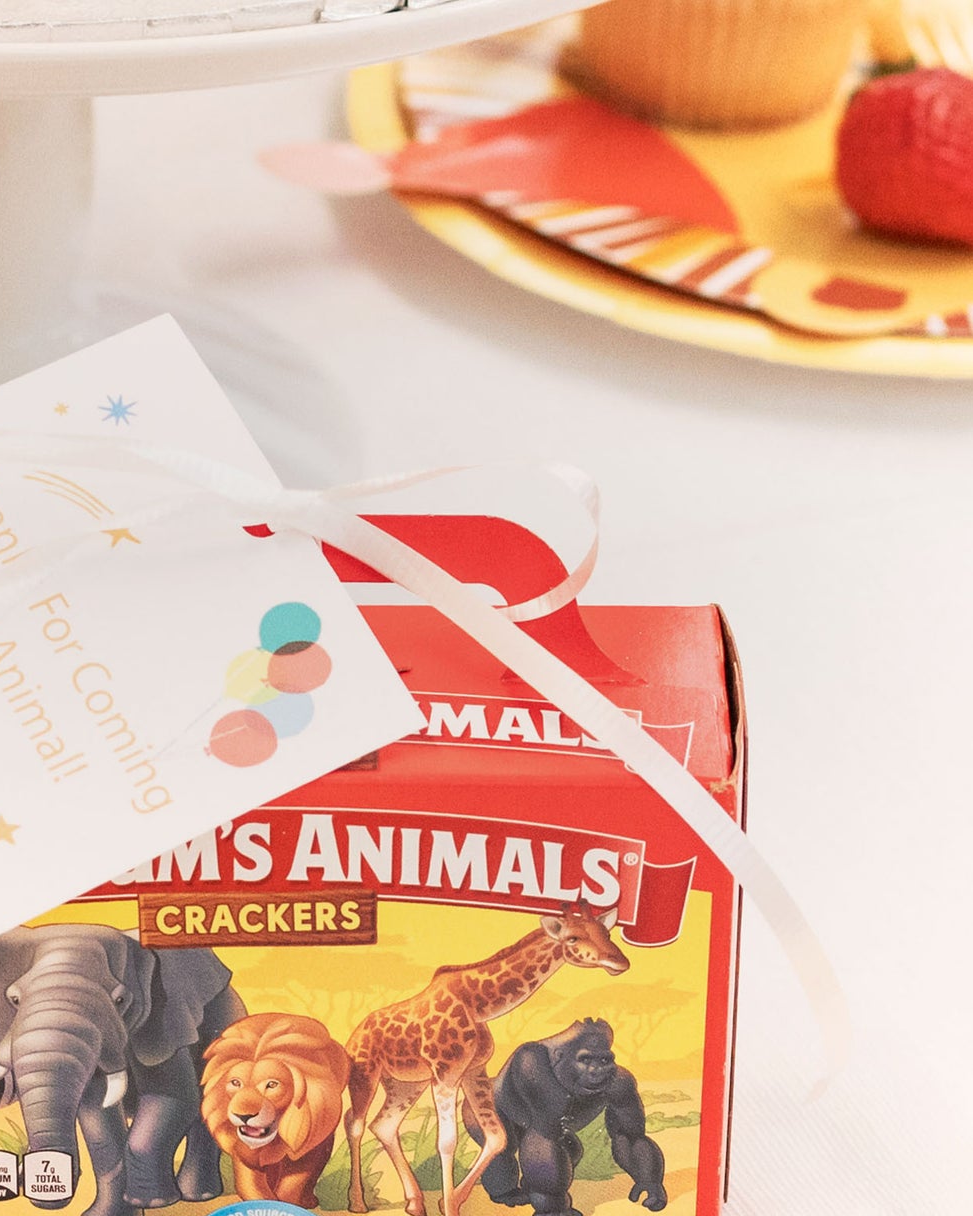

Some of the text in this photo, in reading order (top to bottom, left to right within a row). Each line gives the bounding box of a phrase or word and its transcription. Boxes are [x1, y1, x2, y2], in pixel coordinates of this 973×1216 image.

[28, 592, 83, 654] For
[71, 661, 175, 815] Coming
[155, 901, 362, 936] CRACKERS
[30, 1184, 67, 1194] SUGARS
[35, 1174, 63, 1184] TOTAL
